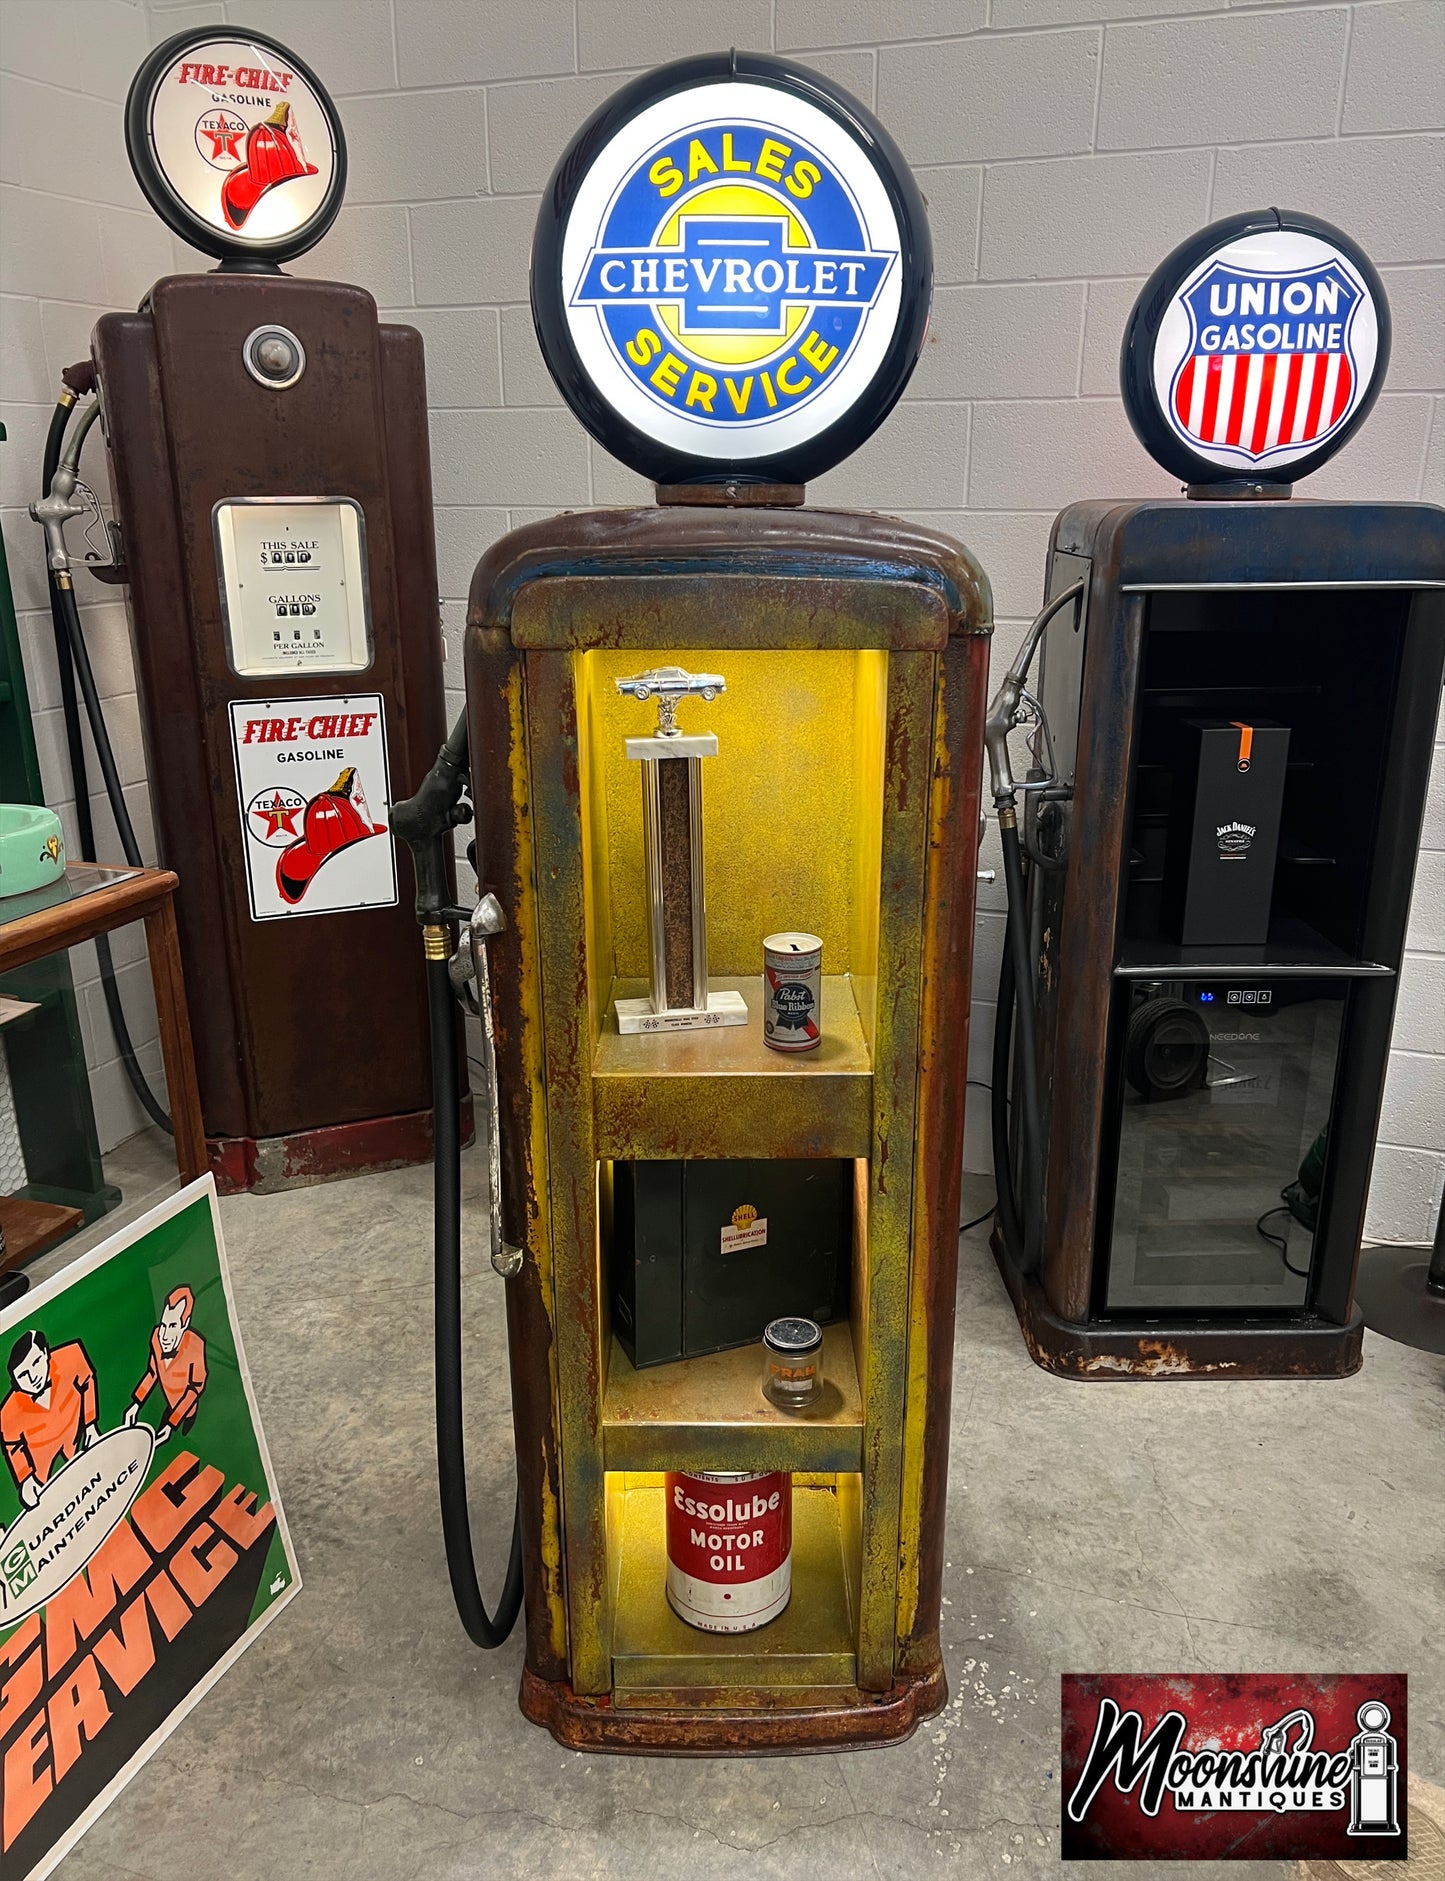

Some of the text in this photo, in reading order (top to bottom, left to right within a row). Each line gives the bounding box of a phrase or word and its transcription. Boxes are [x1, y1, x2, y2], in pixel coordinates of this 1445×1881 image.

[178, 63, 293, 93] FIRE-CHIEF
[211, 93, 272, 107] GASOLINE
[202, 120, 245, 131] TEXACO
[648, 132, 822, 199] SALES
[600, 258, 866, 296] CHEVROLET
[1209, 281, 1340, 317] UNION
[1200, 322, 1342, 351] GASOLINE
[625, 328, 839, 414] SERVICE
[260, 541, 319, 550] THIS SALE
[268, 594, 321, 603] GALLONS
[273, 641, 325, 650] PER GALLON
[241, 712, 378, 745] FIRE-CHIEF
[276, 749, 345, 763] GASOLINE
[255, 798, 302, 810] TEXACO
[779, 987, 806, 1001] Pabst
[733, 1212, 755, 1222] SHELL
[722, 1228, 766, 1243] SHELLUBRICATION
[674, 1485, 780, 1522] Essolube
[12, 1459, 139, 1598] MAINTENANCE
[690, 1528, 764, 1551] MOTOR
[710, 1555, 745, 1571] OIL
[2, 1483, 277, 1853] ERVICE
